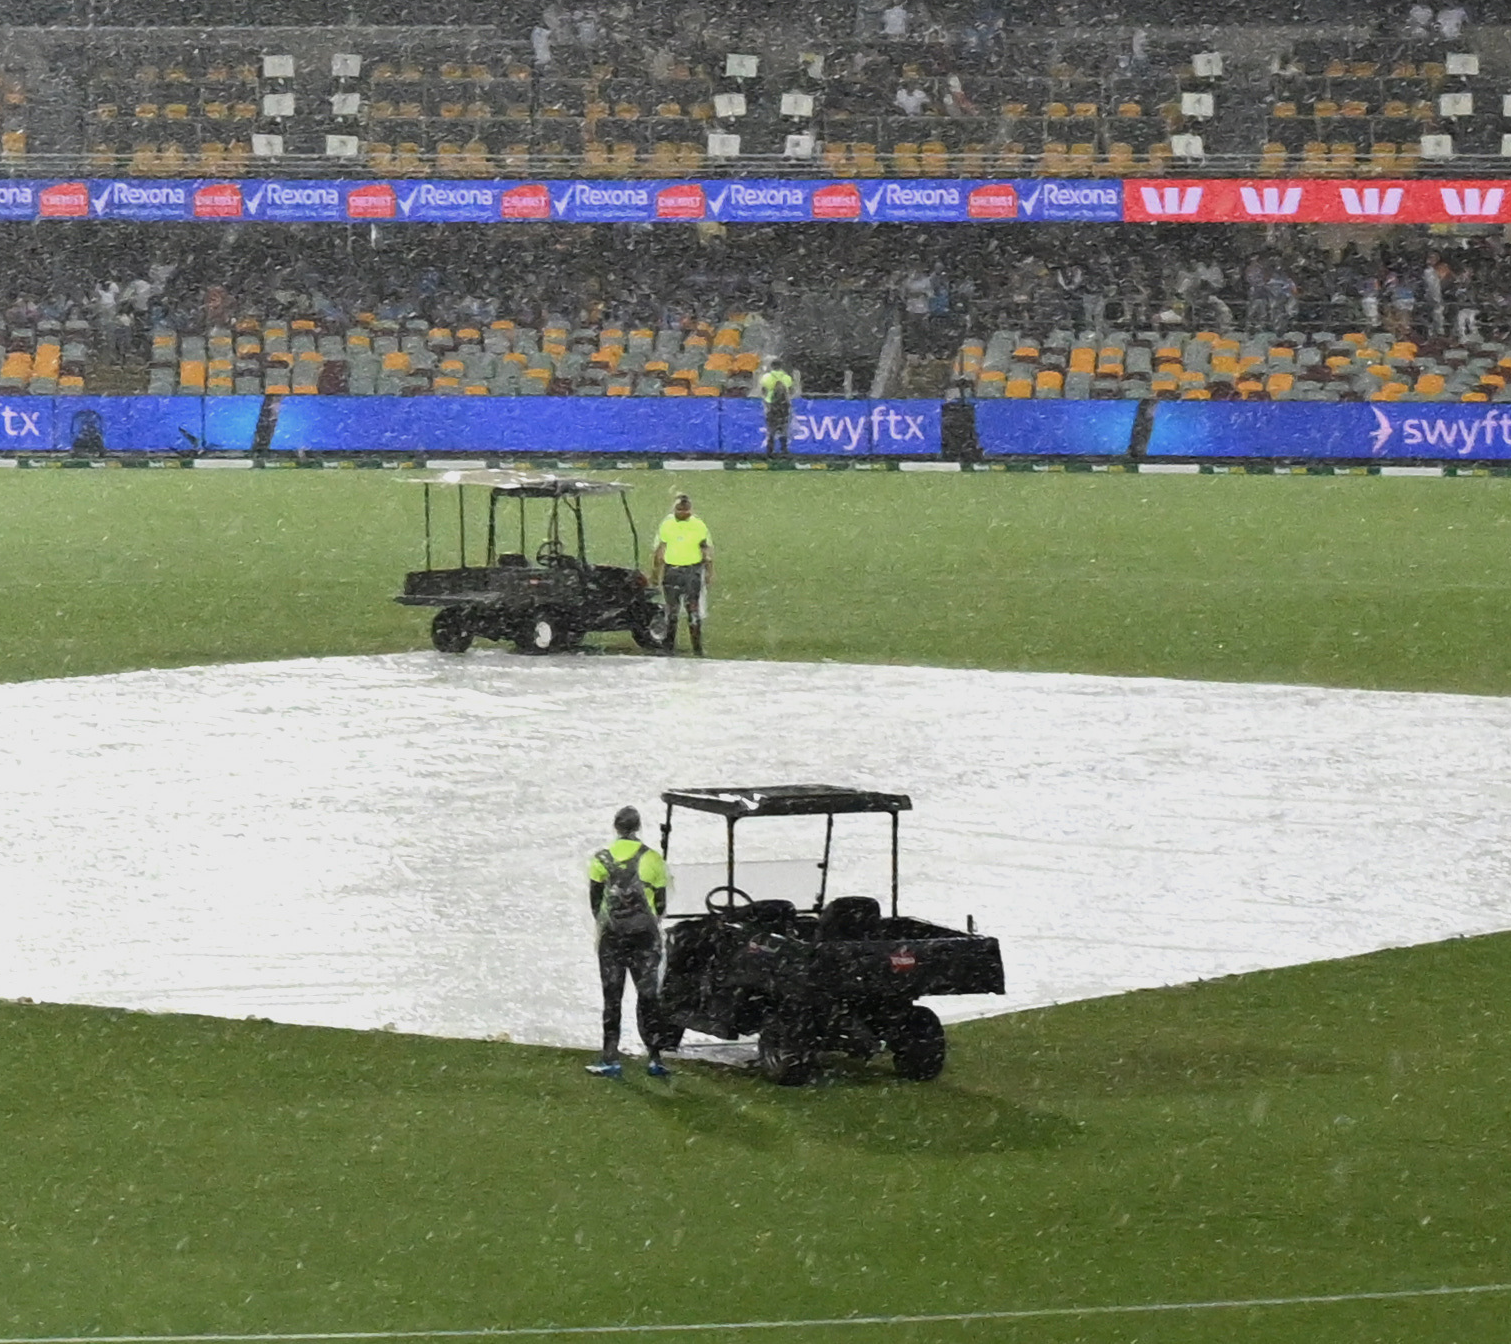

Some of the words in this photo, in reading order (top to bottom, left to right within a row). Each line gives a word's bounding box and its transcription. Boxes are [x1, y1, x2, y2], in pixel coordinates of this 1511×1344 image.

[114, 184, 185, 204] Rexona
[267, 184, 338, 204] Rexona
[420, 184, 493, 205] Rexona
[575, 184, 649, 204] Rexona
[731, 185, 803, 204] Rexona
[887, 184, 959, 205] Rexona
[1044, 185, 1117, 204] Rexona
[791, 406, 924, 450] swyftx
